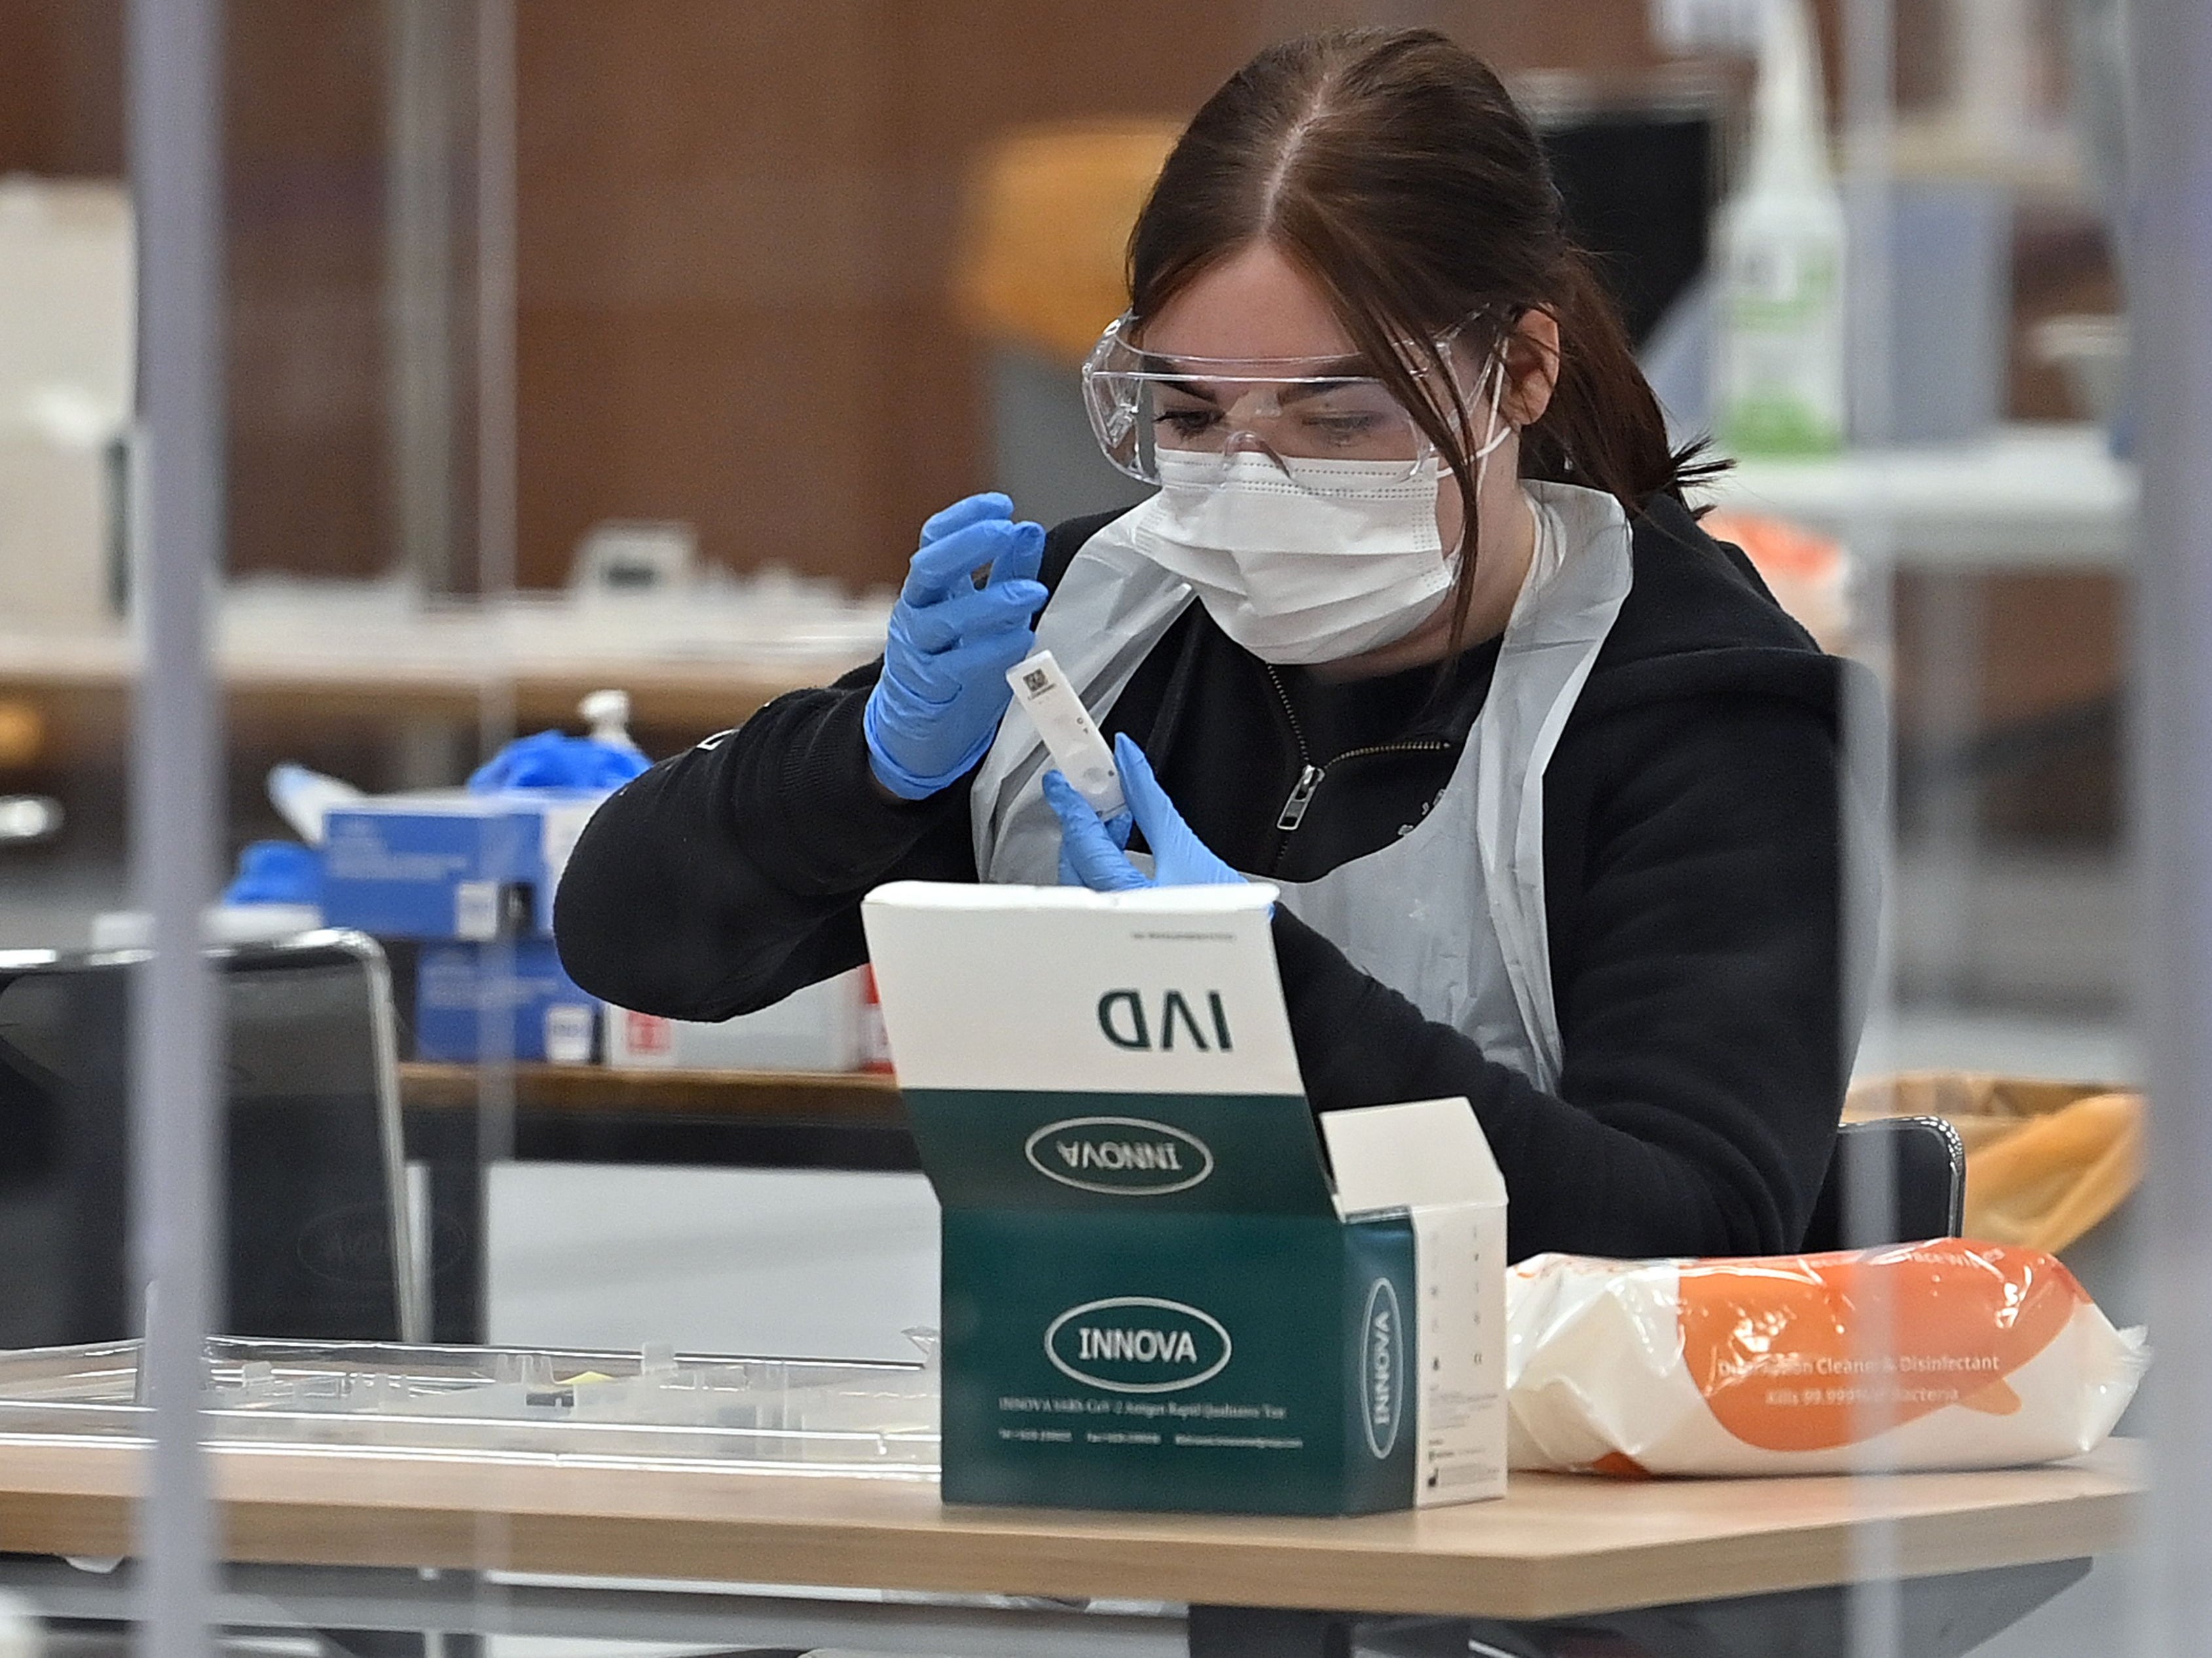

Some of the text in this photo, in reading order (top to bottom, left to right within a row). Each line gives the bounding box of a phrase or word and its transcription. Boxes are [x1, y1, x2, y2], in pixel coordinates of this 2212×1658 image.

[1097, 988, 1233, 1052] IVD
[1056, 1140, 1183, 1170] INNOVA
[1078, 1327, 1198, 1364] INNOVA
[1900, 1355, 2000, 1372] Disinfectant
[1374, 1310, 1390, 1424] INNOVA
